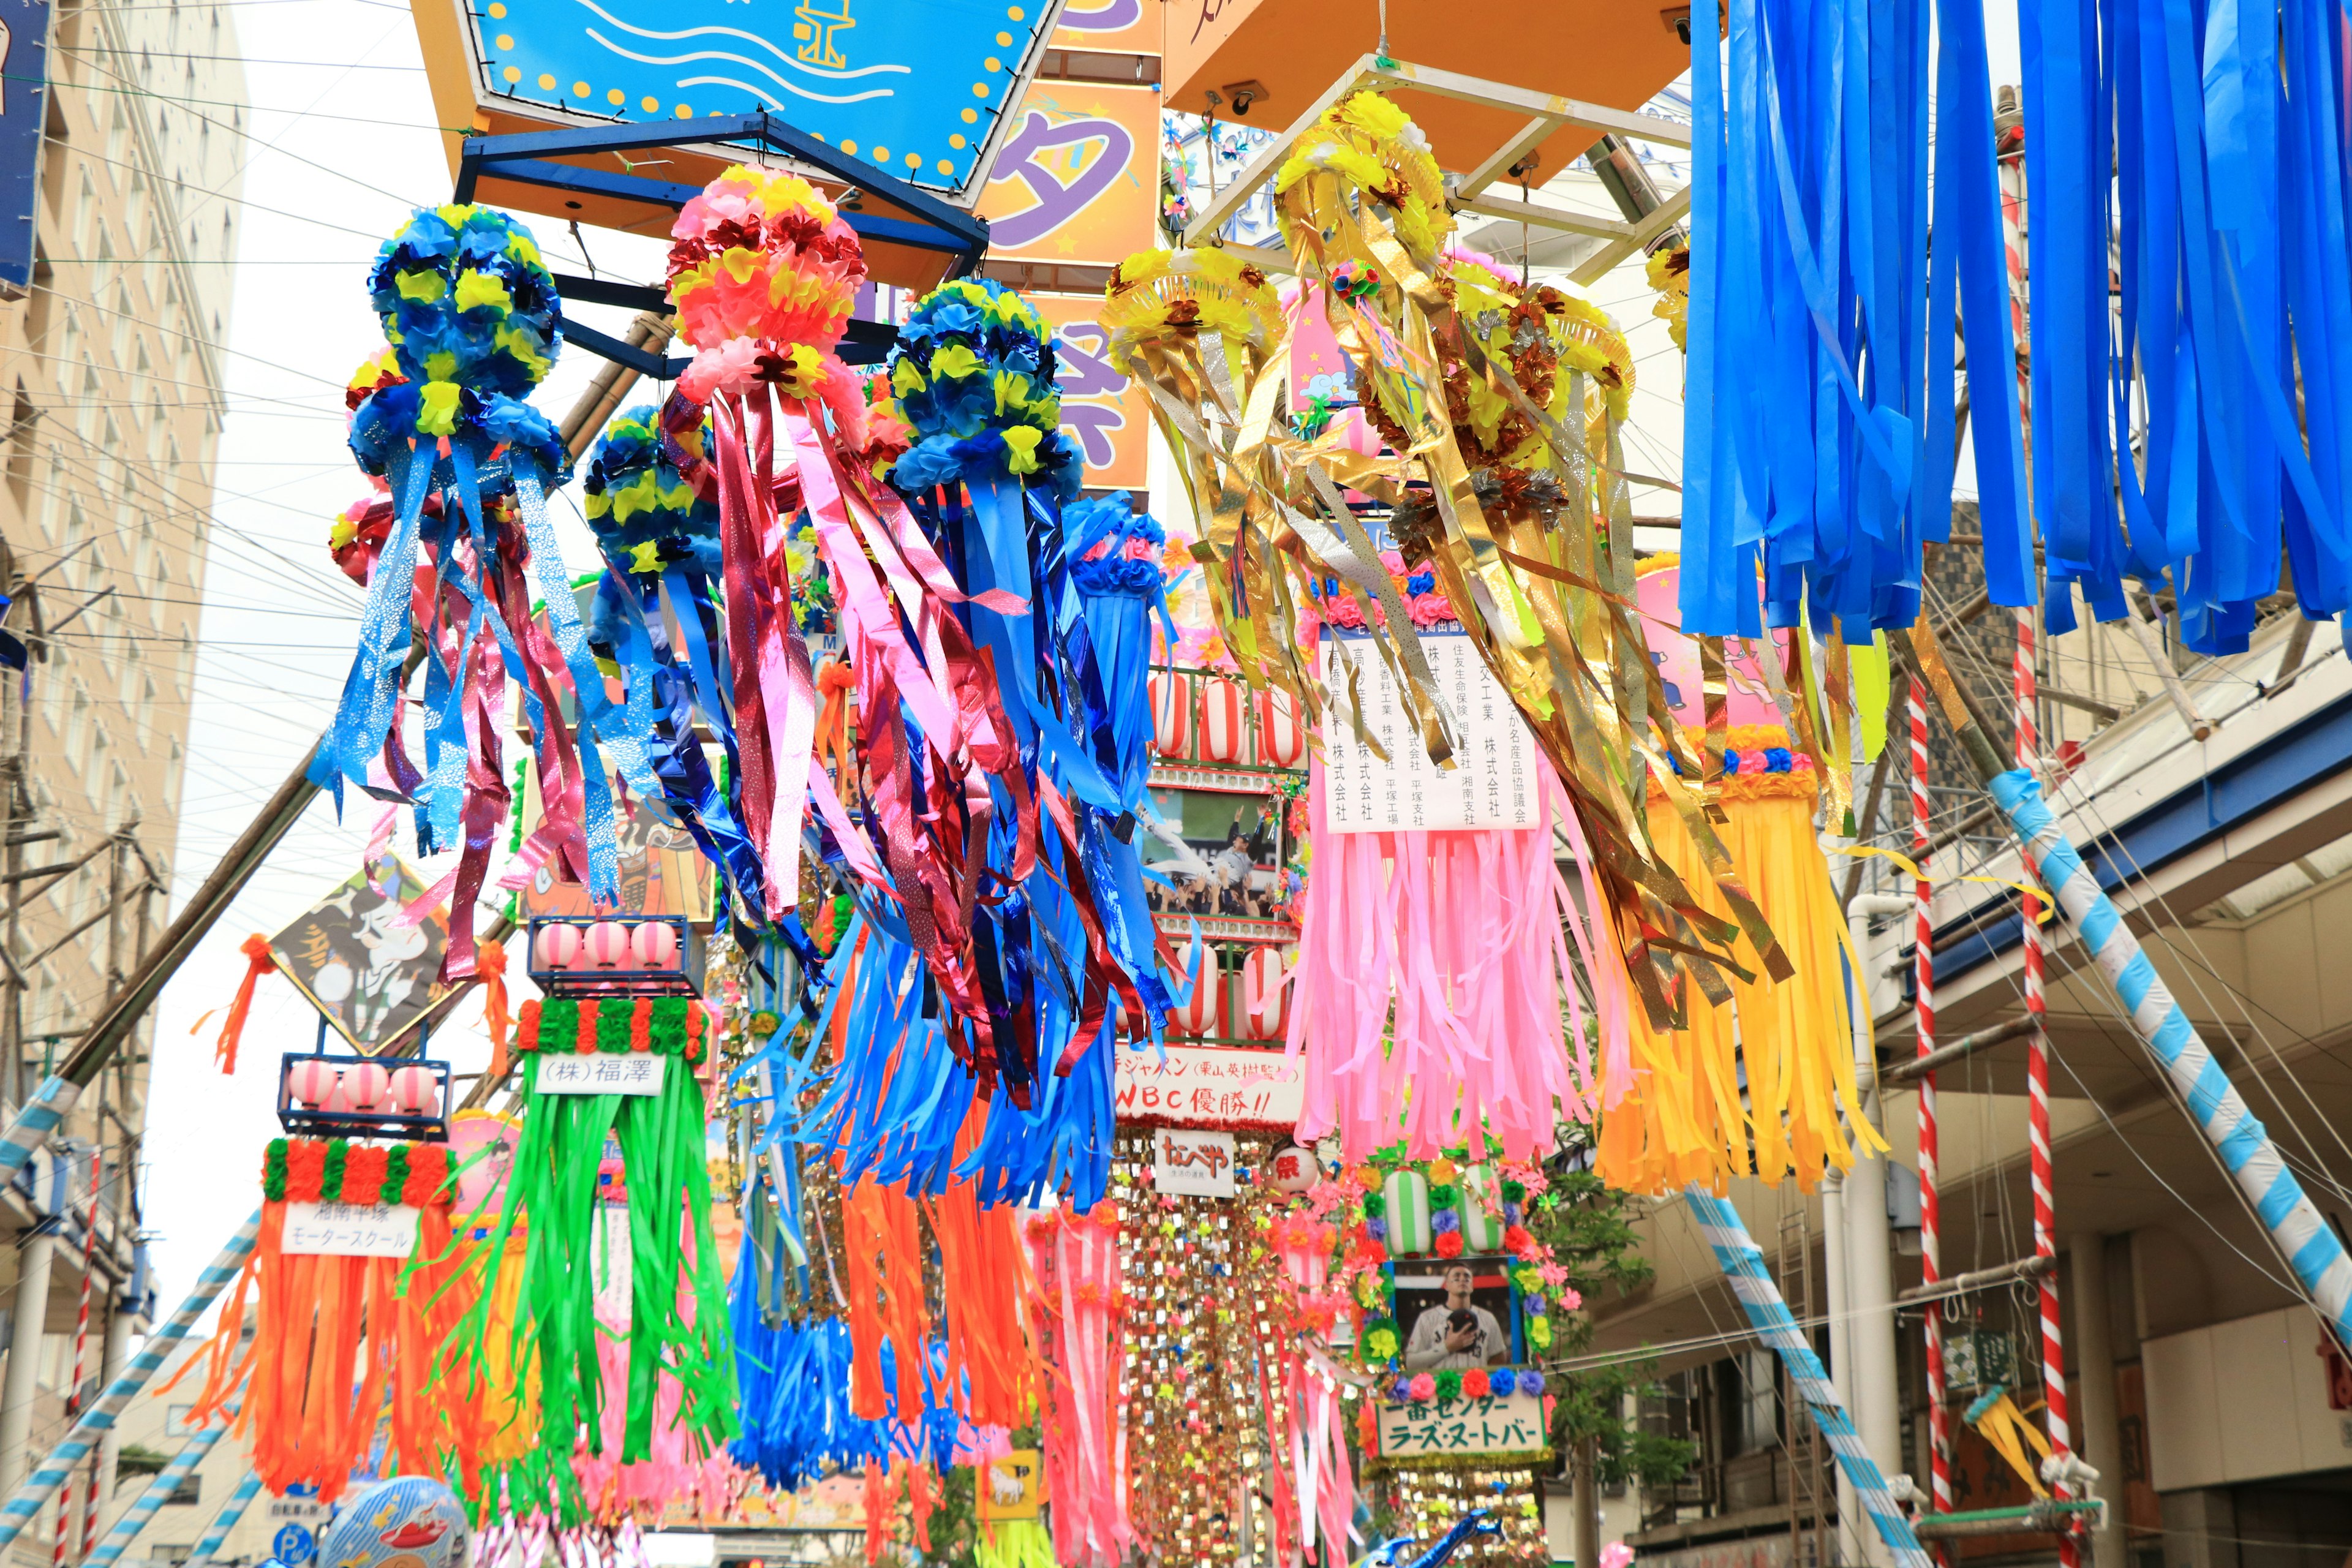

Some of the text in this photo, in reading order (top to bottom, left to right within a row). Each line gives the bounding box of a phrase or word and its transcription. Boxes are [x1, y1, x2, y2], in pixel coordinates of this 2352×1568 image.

[1378, 652, 1398, 824] 砂香料工業 株式会社 平塚工場
[1453, 644, 1468, 716] 住友生命保険
[1461, 776, 1476, 825] 湘南支社
[1479, 646, 1500, 818] 交工業 株式会社
[1332, 742, 1348, 822] 株式会社
[1357, 742, 1373, 821] 株式会社
[1411, 780, 1424, 826] 平塚支社
[546, 1060, 652, 1082] (株)福澤
[1115, 1053, 1298, 1083] ジャパン(栗山英樹監)
[1162, 1135, 1229, 1178] なべや
[1170, 1170, 1205, 1179] 生活の道具
[1276, 1155, 1300, 1181] 祭
[292, 1227, 408, 1249] モータースクール
[1384, 1395, 1509, 1422] 一番センター
[1389, 1419, 1536, 1450] ラーズ・ヌートバー
